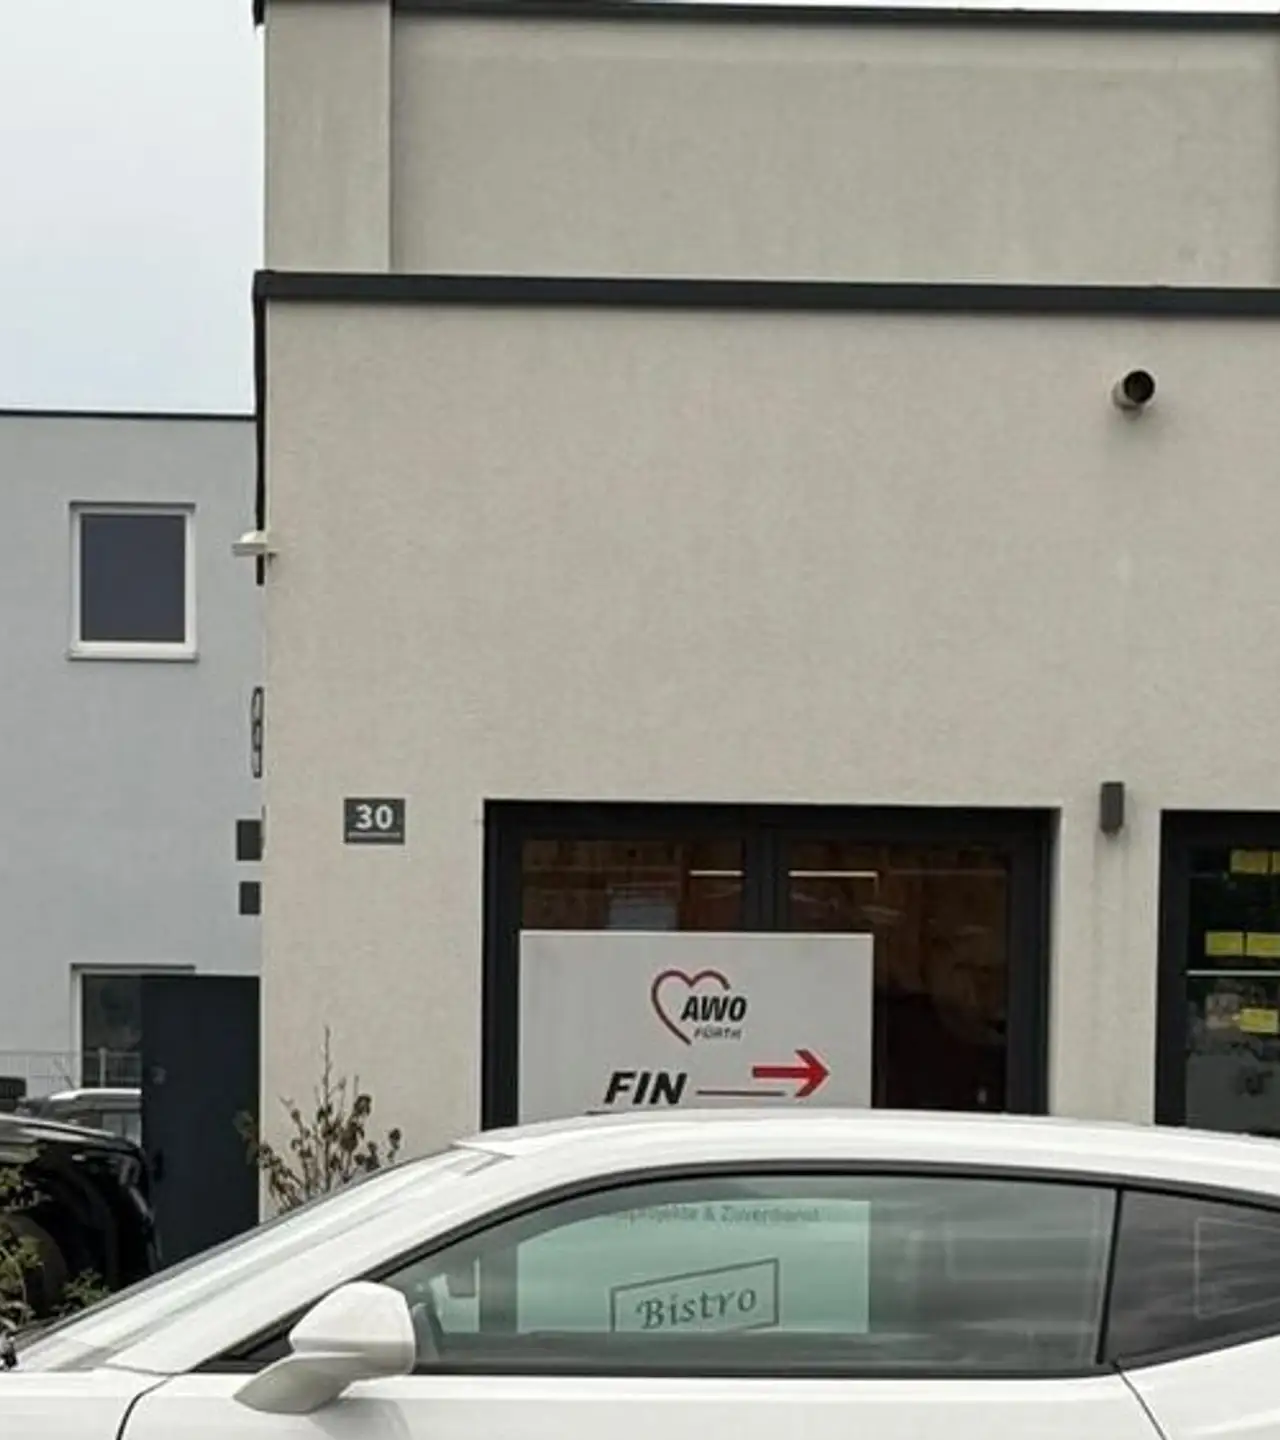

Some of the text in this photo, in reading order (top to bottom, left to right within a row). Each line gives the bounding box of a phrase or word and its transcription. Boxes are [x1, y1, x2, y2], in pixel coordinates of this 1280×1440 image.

[355, 803, 394, 830] 30
[680, 995, 748, 1022] AWO
[603, 1071, 688, 1105] FIN
[635, 1288, 757, 1330] Bistro
